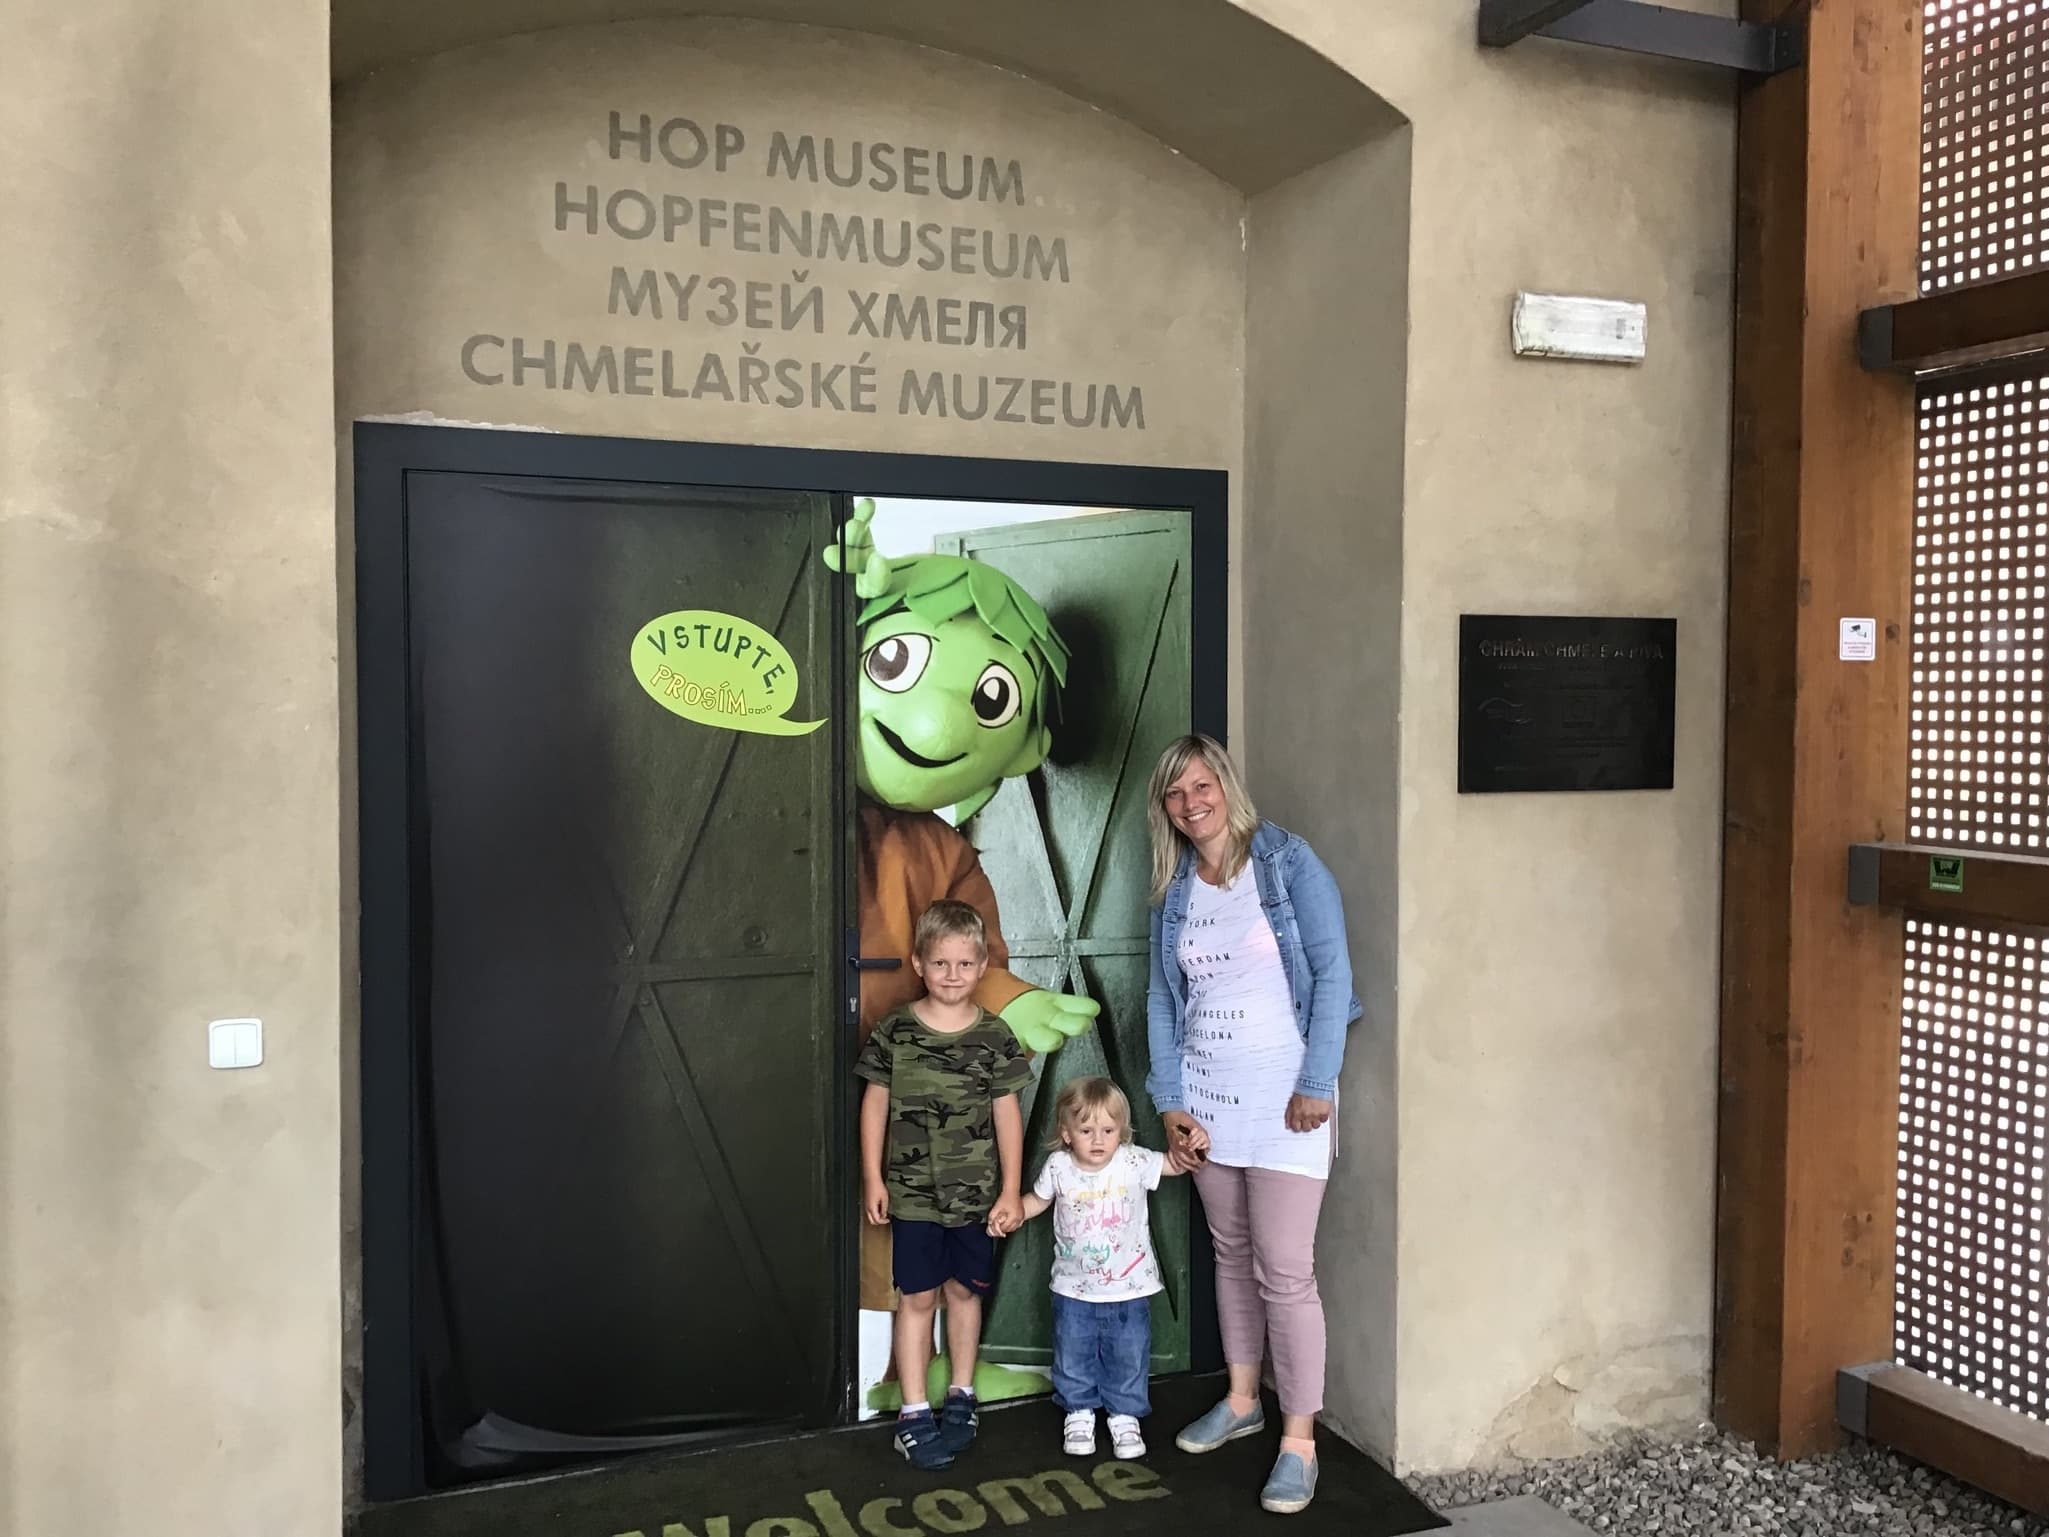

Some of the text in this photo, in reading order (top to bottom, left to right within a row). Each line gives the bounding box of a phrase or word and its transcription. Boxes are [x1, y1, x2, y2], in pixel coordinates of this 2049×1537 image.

[608, 111, 1025, 206] HOP MUSEUM
[554, 182, 1070, 283] HOPFENMUSEUM
[607, 267, 1027, 350] МУЗЕЙ ХМЕЛЯ
[461, 334, 1146, 430] CHMELAŘSKÉ MUZEUM
[647, 624, 786, 695] VSTUPTE,
[1189, 918, 1216, 929] YORK
[1189, 1083, 1240, 1105] STOCKHOLM
[1190, 1105, 1215, 1122] MILAN
[612, 1461, 1172, 1537] lcome
